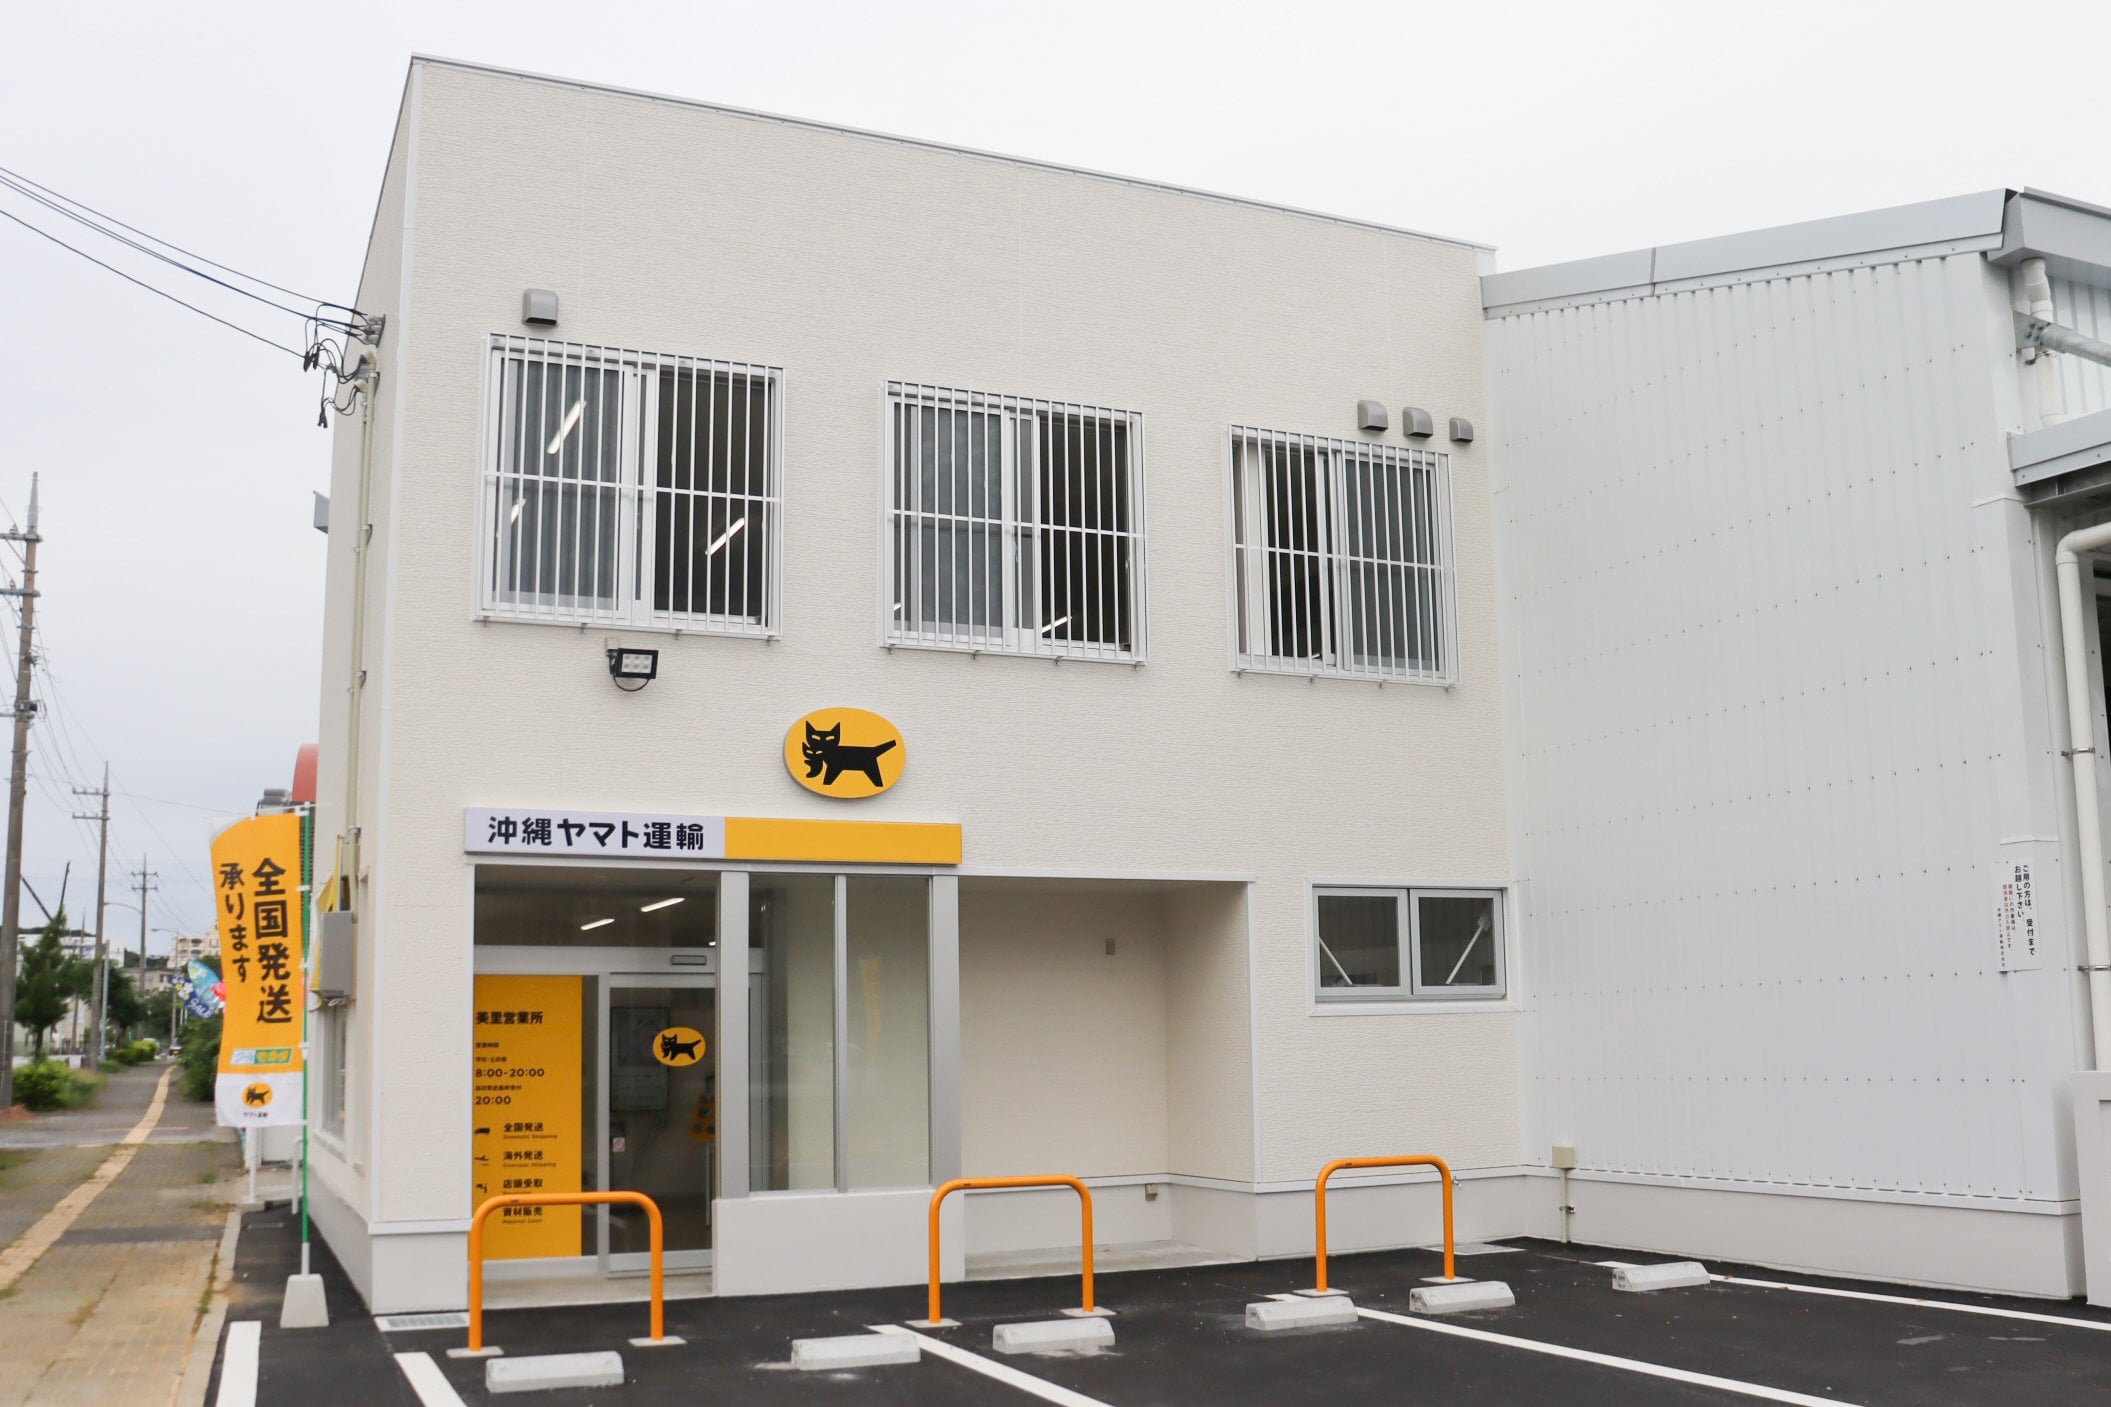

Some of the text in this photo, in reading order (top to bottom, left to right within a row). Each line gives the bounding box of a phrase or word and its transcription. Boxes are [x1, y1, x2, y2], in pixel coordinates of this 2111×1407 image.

[487, 815, 704, 851] 沖縄ヤマト運輸
[219, 862, 251, 983] 承ります
[252, 858, 293, 1023] 全国発送
[188, 997, 215, 1018] SALE
[476, 1011, 544, 1025] 美里営業所
[475, 1068, 545, 1077] 8:00-20:00
[475, 1095, 512, 1105] 20:00
[503, 1122, 544, 1133] 全国発送
[503, 1150, 544, 1161] 海外発送
[502, 1178, 544, 1189] 店頭受取
[502, 1206, 543, 1217] 資材販売
